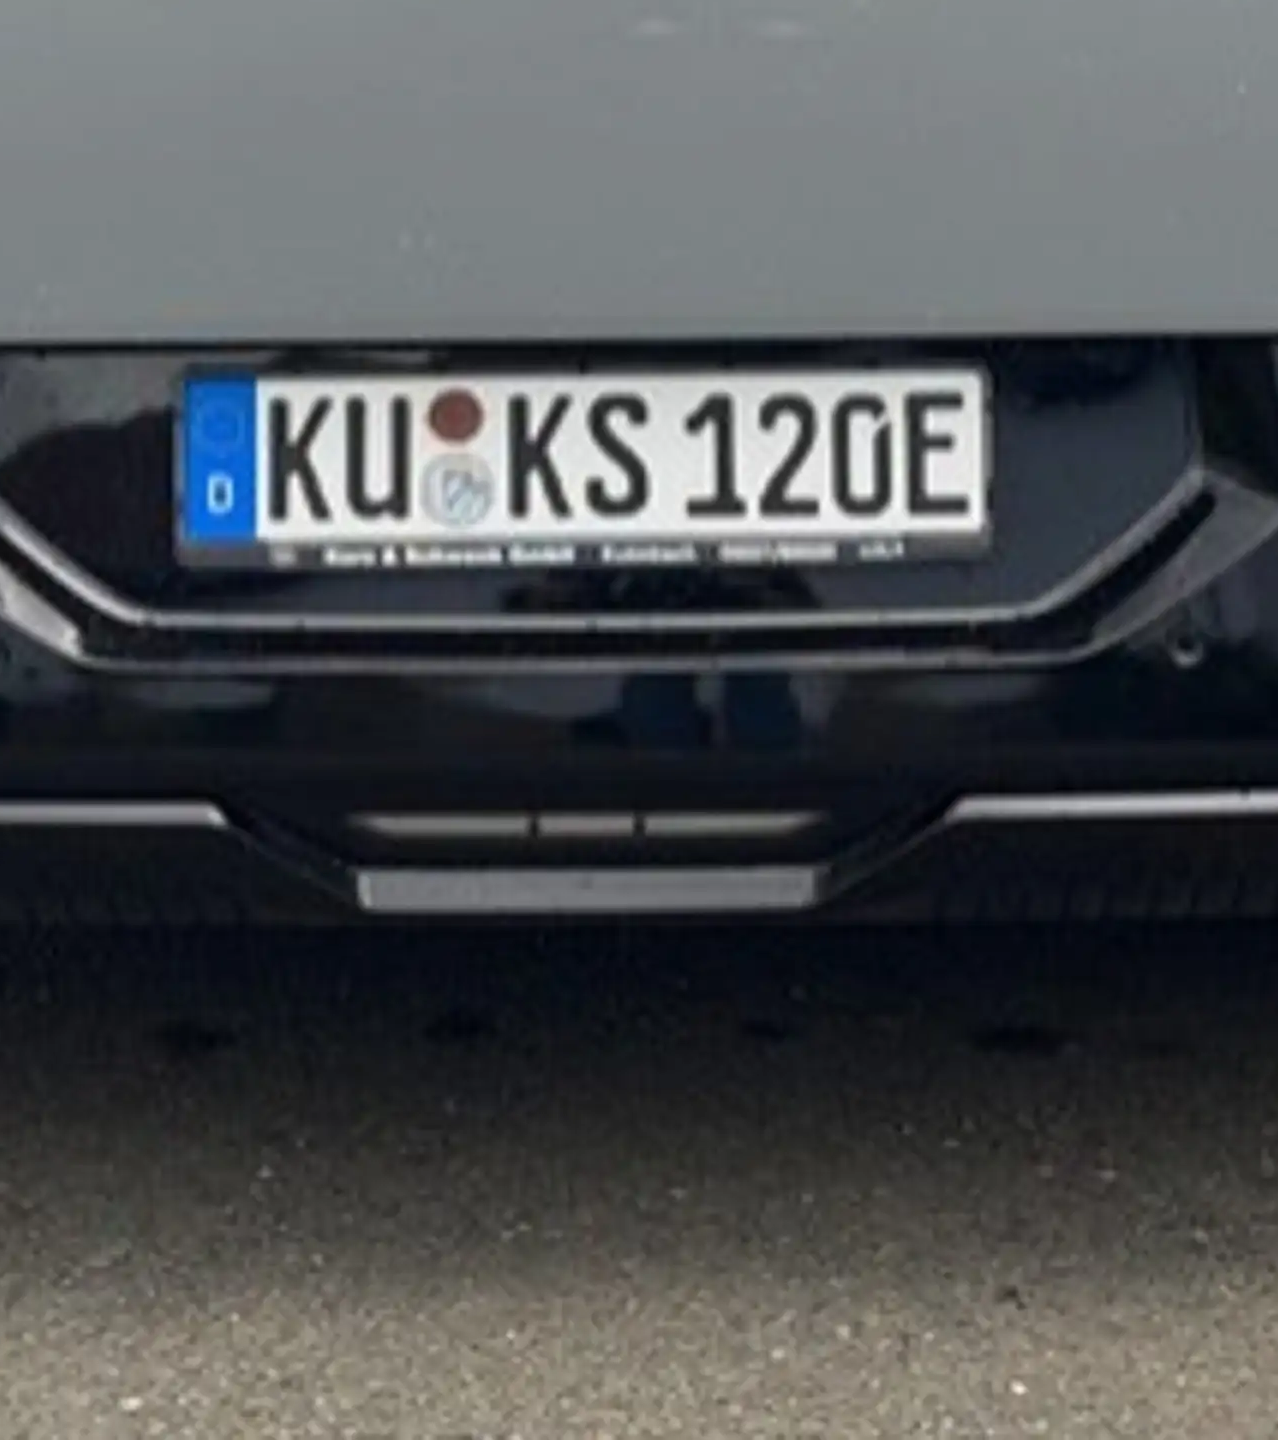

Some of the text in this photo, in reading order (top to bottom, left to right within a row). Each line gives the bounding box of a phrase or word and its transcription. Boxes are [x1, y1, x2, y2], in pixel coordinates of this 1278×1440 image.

[269, 392, 971, 520] KU KS 120E
